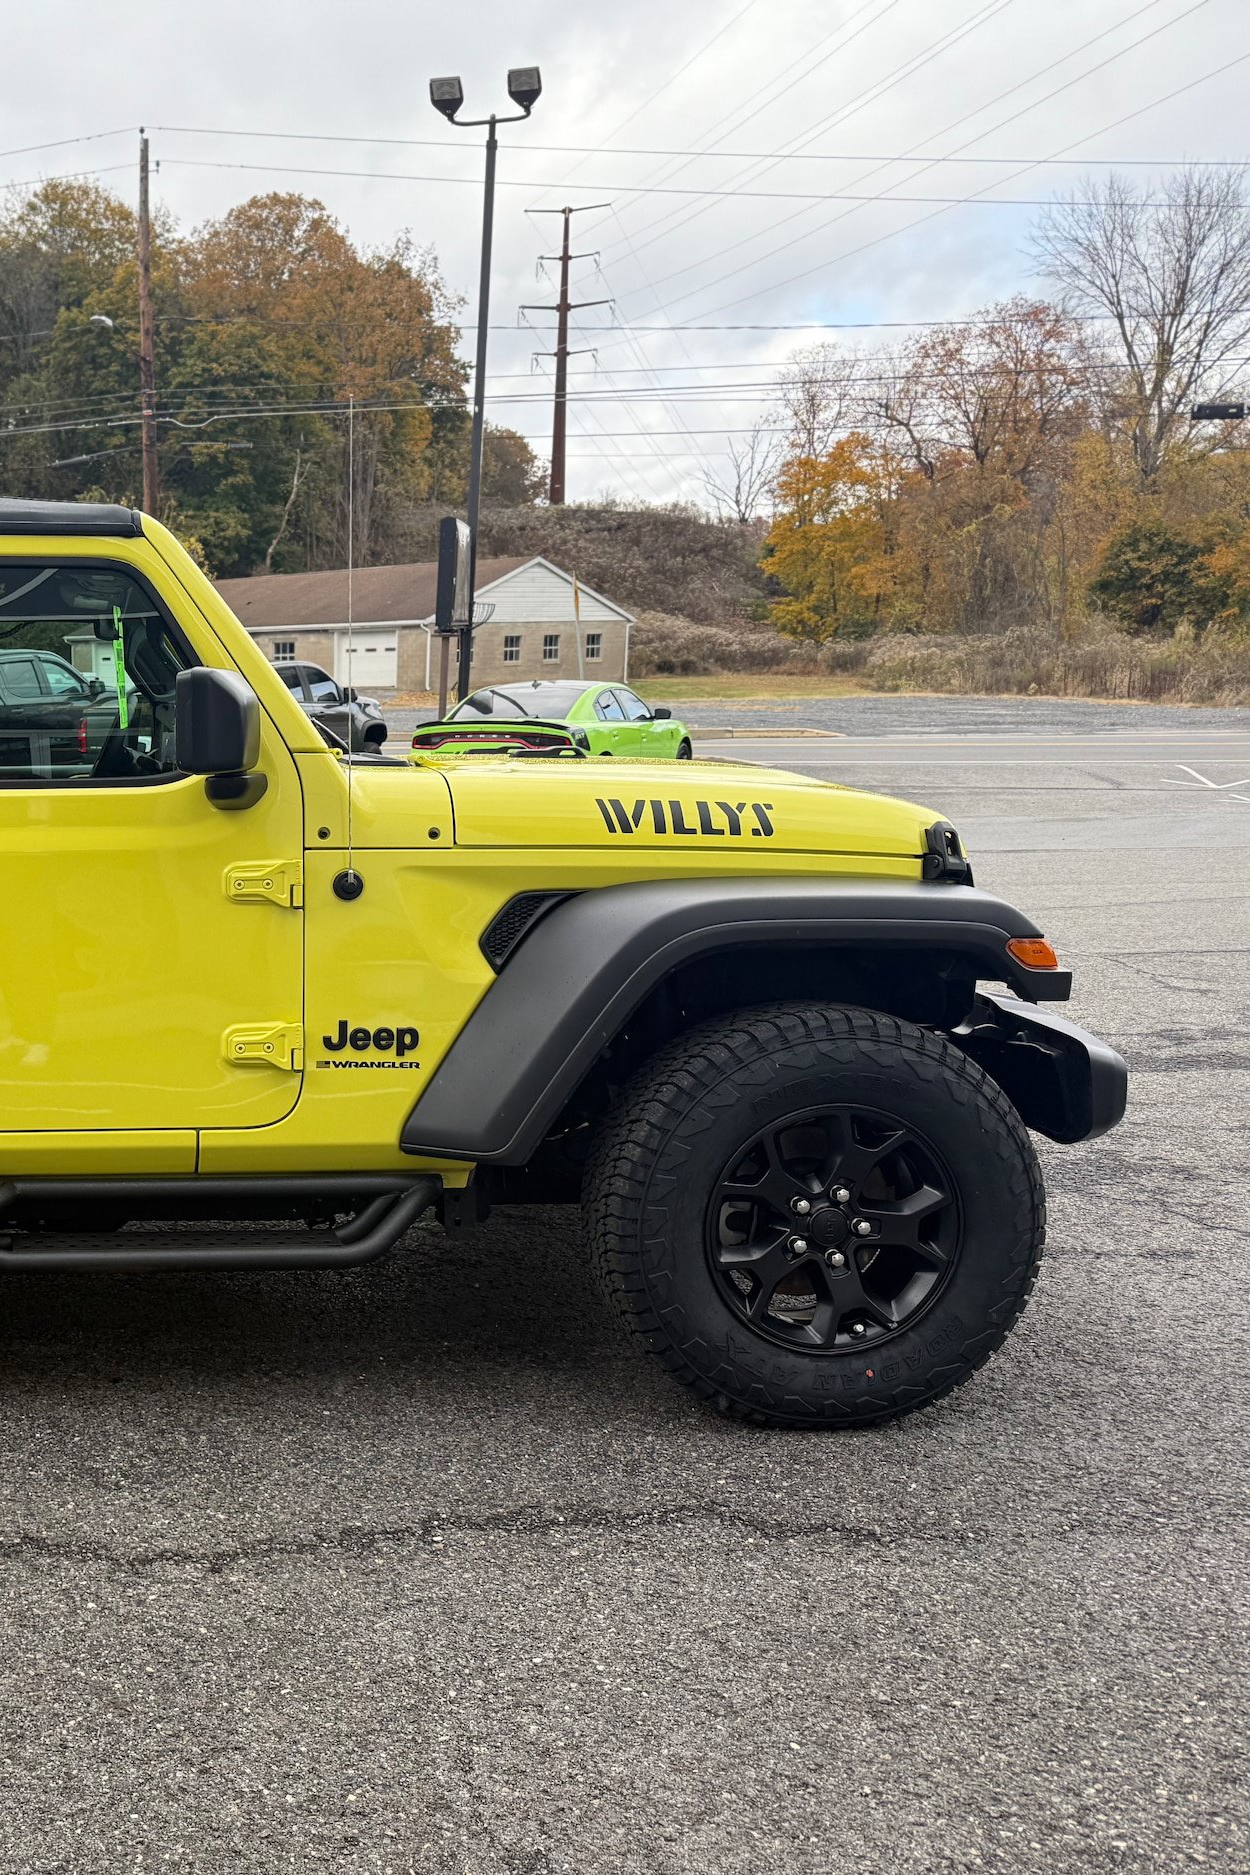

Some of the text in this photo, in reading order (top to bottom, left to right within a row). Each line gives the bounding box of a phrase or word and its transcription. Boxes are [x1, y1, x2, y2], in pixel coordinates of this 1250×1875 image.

[595, 798, 774, 836] WILLYS
[322, 1020, 420, 1056] Jeep
[332, 1060, 420, 1069] WRANGLER
[752, 1072, 919, 1113] NEXEN
